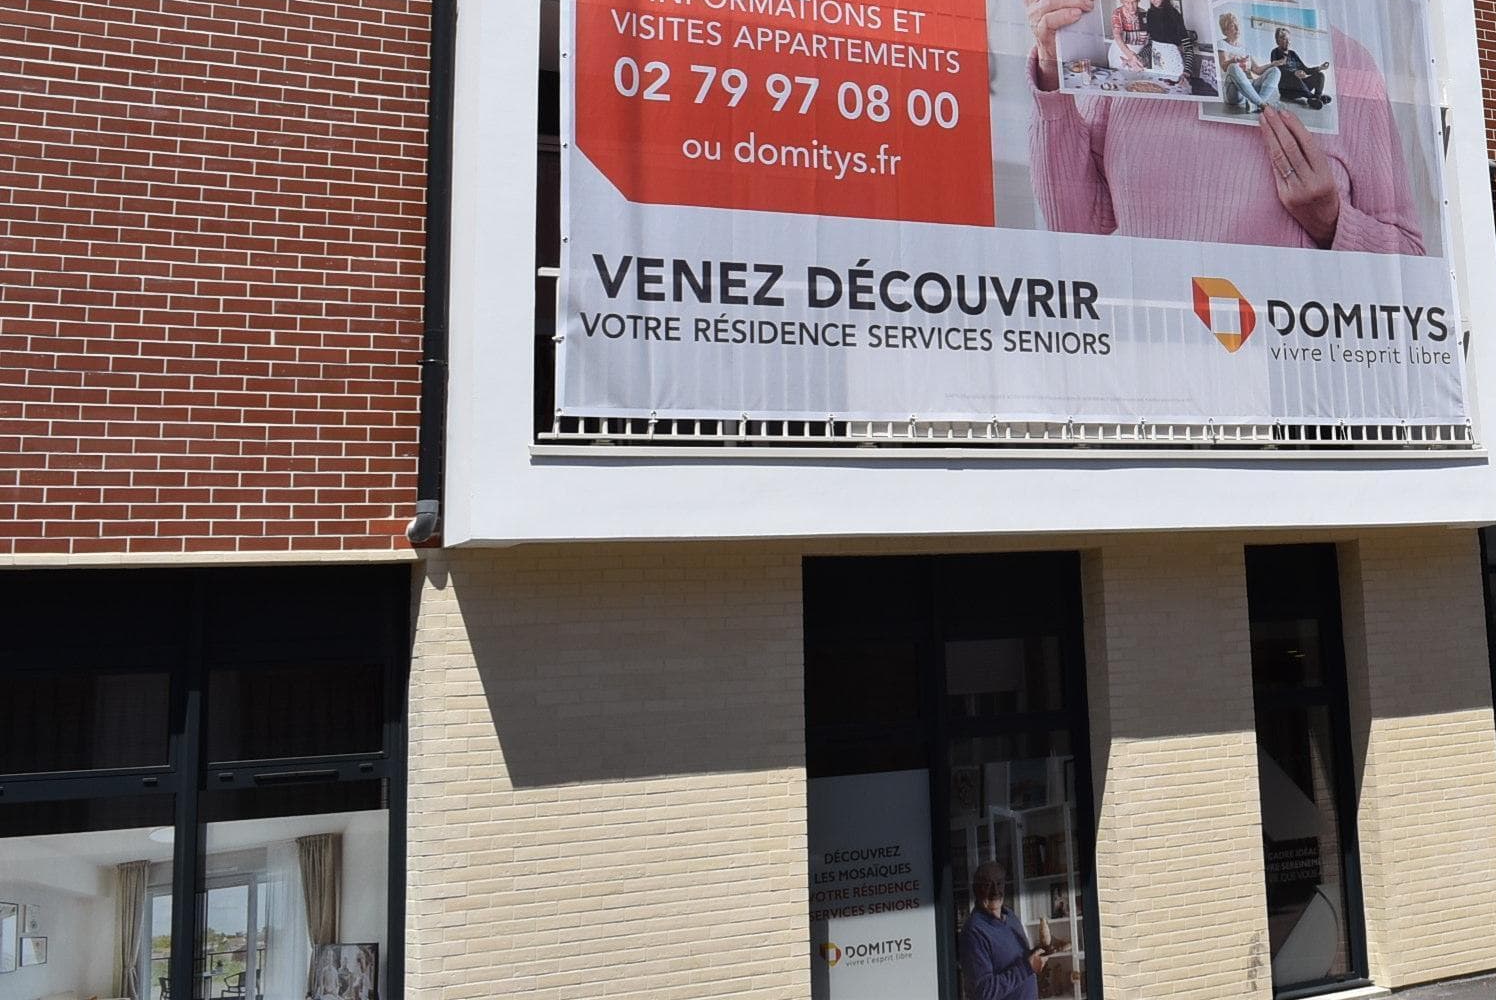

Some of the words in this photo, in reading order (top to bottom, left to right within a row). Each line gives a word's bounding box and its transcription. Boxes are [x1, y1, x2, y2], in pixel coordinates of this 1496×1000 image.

[893, 9, 926, 34] ET
[610, 9, 723, 46] VISITES
[732, 25, 961, 75] APPARTEMENTS
[613, 56, 671, 102] 02
[690, 64, 748, 108] 79
[765, 73, 820, 115] 97
[837, 81, 891, 123] 08
[906, 88, 960, 129] 00
[682, 137, 722, 161] ou
[734, 131, 901, 180] domitys.fr
[592, 253, 784, 307] VENEZ
[807, 258, 1100, 320] DÉCOUVRIR
[1267, 299, 1448, 342] DOMITYS
[580, 312, 681, 342] VOTRE
[694, 313, 857, 347] RÉSIDENCE
[868, 324, 993, 351] SERVICES
[1003, 329, 1111, 356] SENIORS
[1270, 342, 1322, 362] vivre
[1330, 343, 1401, 368] l'esprit
[1409, 346, 1451, 364] libre
[824, 845, 900, 864] DÉCOUVREZ
[814, 871, 835, 885] LES
[853, 879, 920, 898] RÉSIDENCE
[868, 898, 920, 914] SENIORS
[844, 938, 912, 959] DOMITYS
